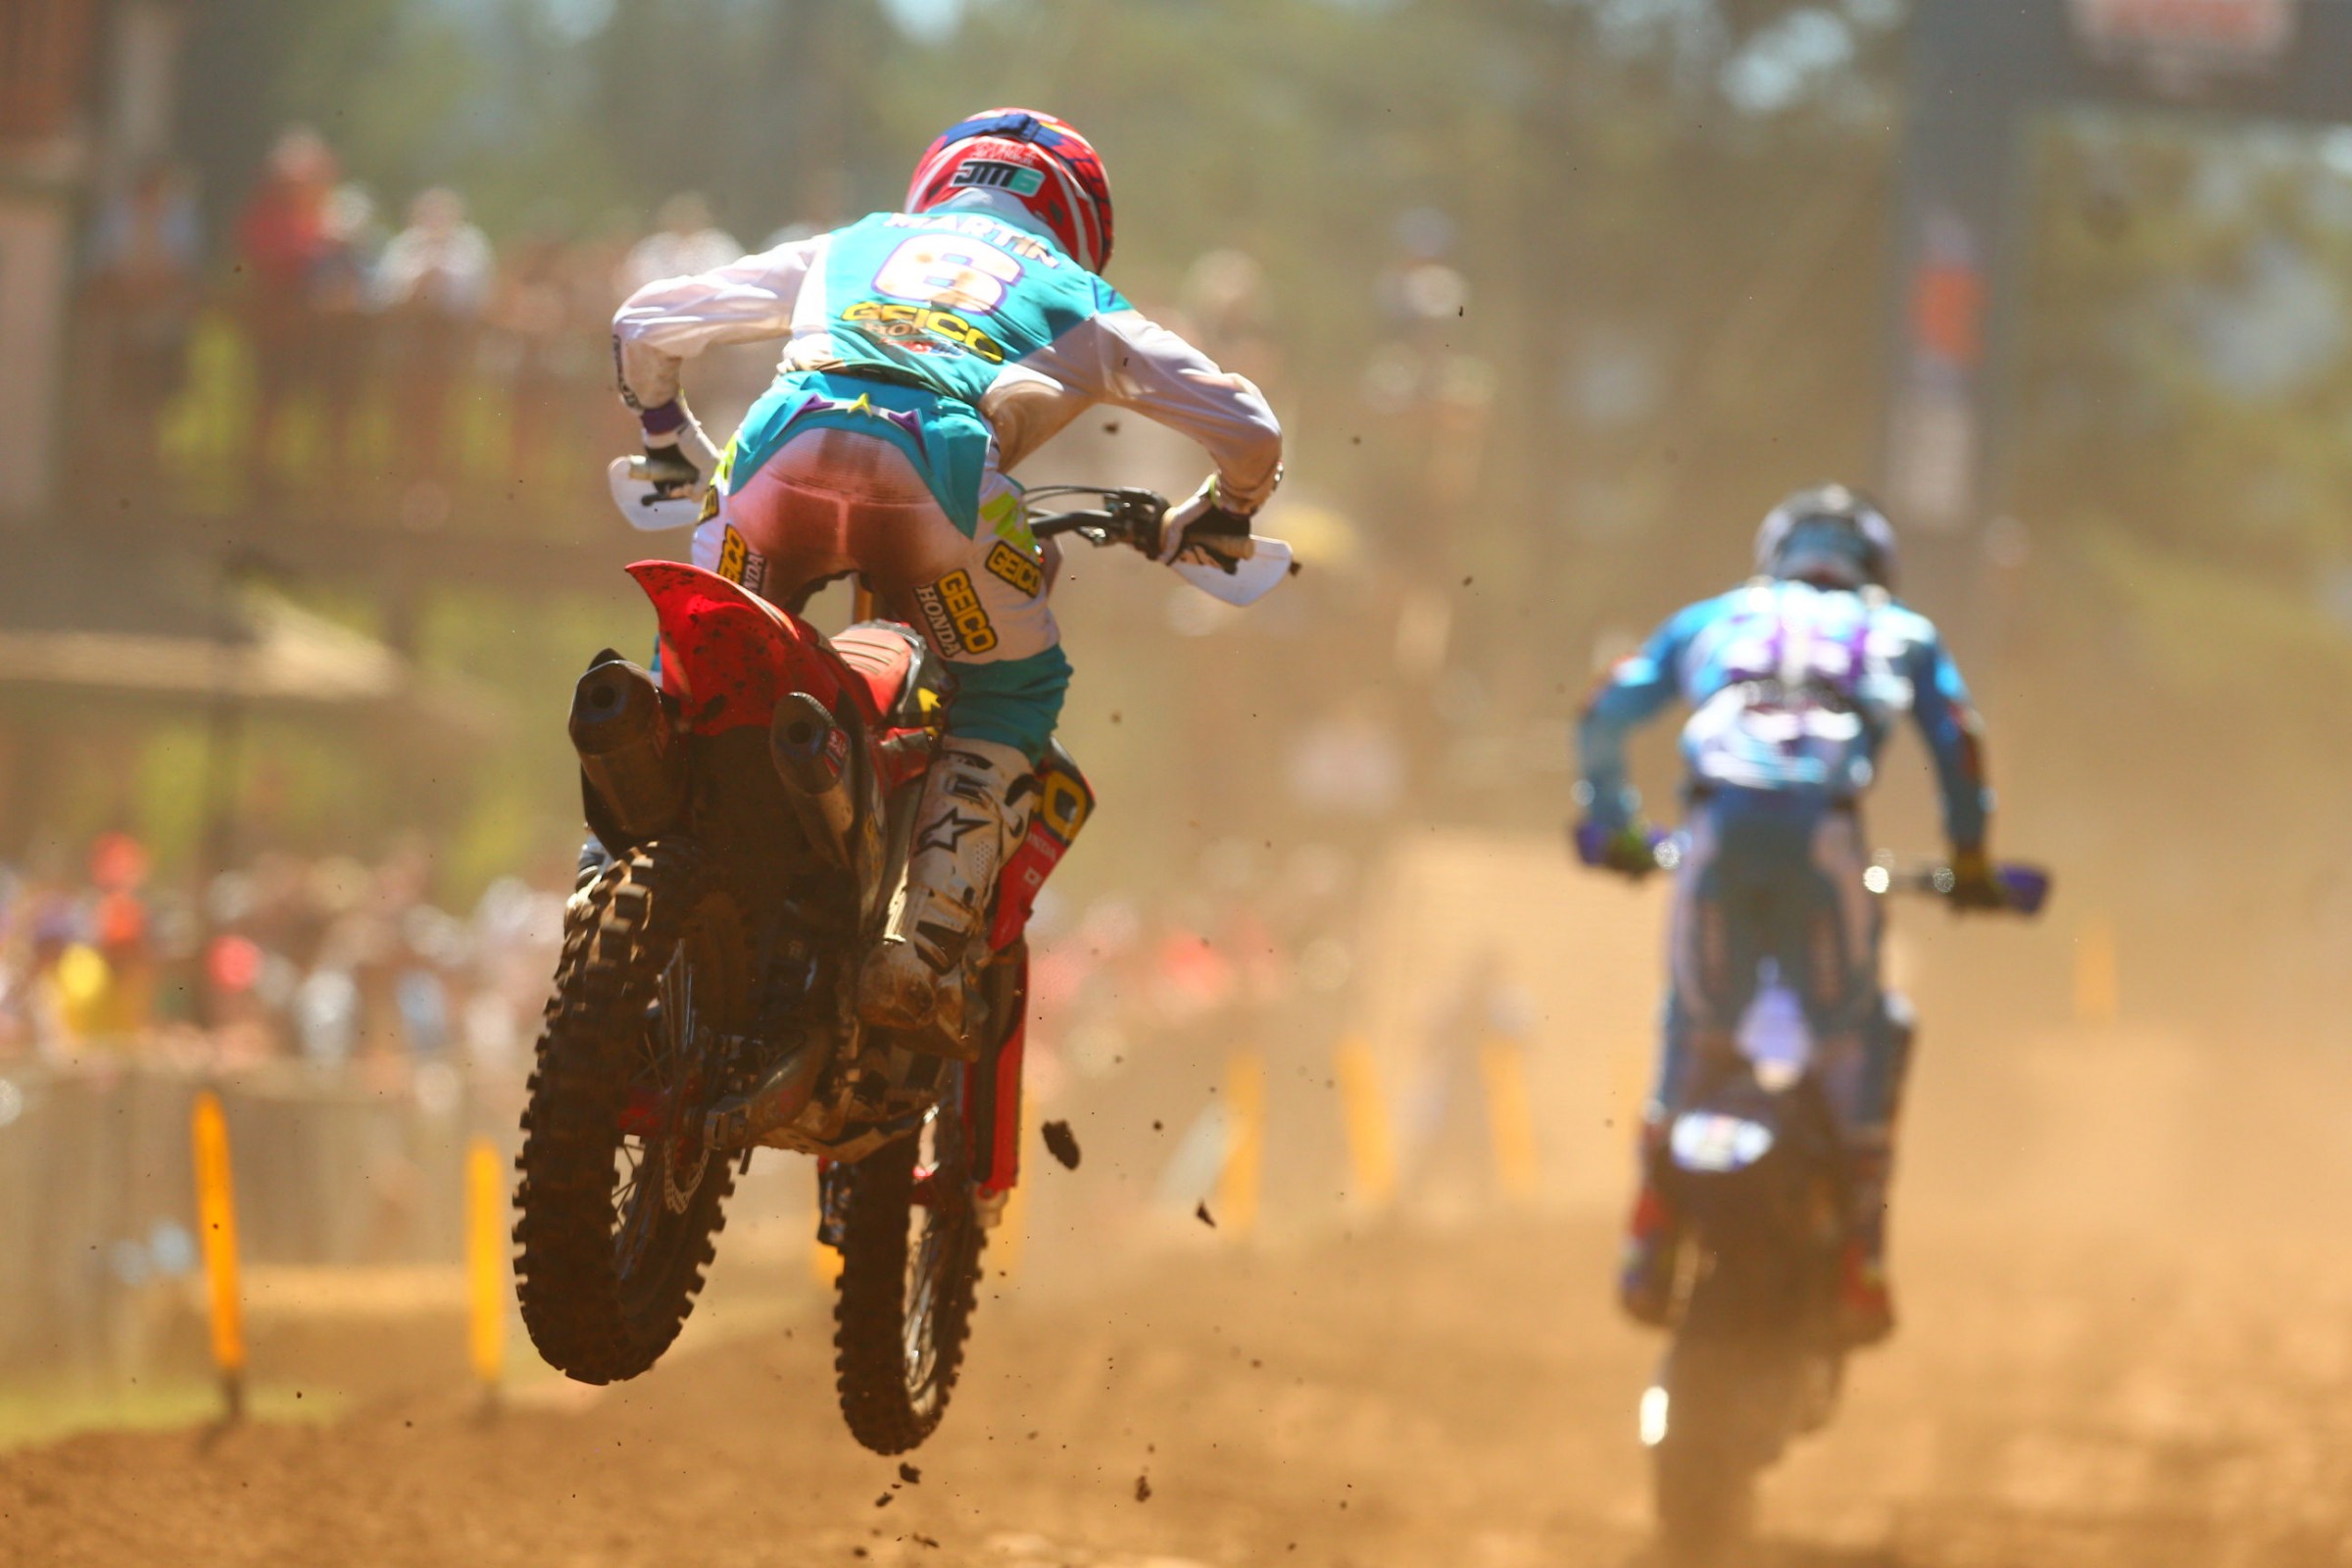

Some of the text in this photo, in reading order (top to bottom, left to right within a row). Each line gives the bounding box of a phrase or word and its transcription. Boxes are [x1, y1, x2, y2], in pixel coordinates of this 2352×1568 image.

[883, 213, 1059, 269] MARTIN
[841, 301, 1004, 365] GEICO
[987, 542, 1042, 597] GEICO
[914, 584, 961, 657] HONDA
[938, 569, 997, 655] GEICO
